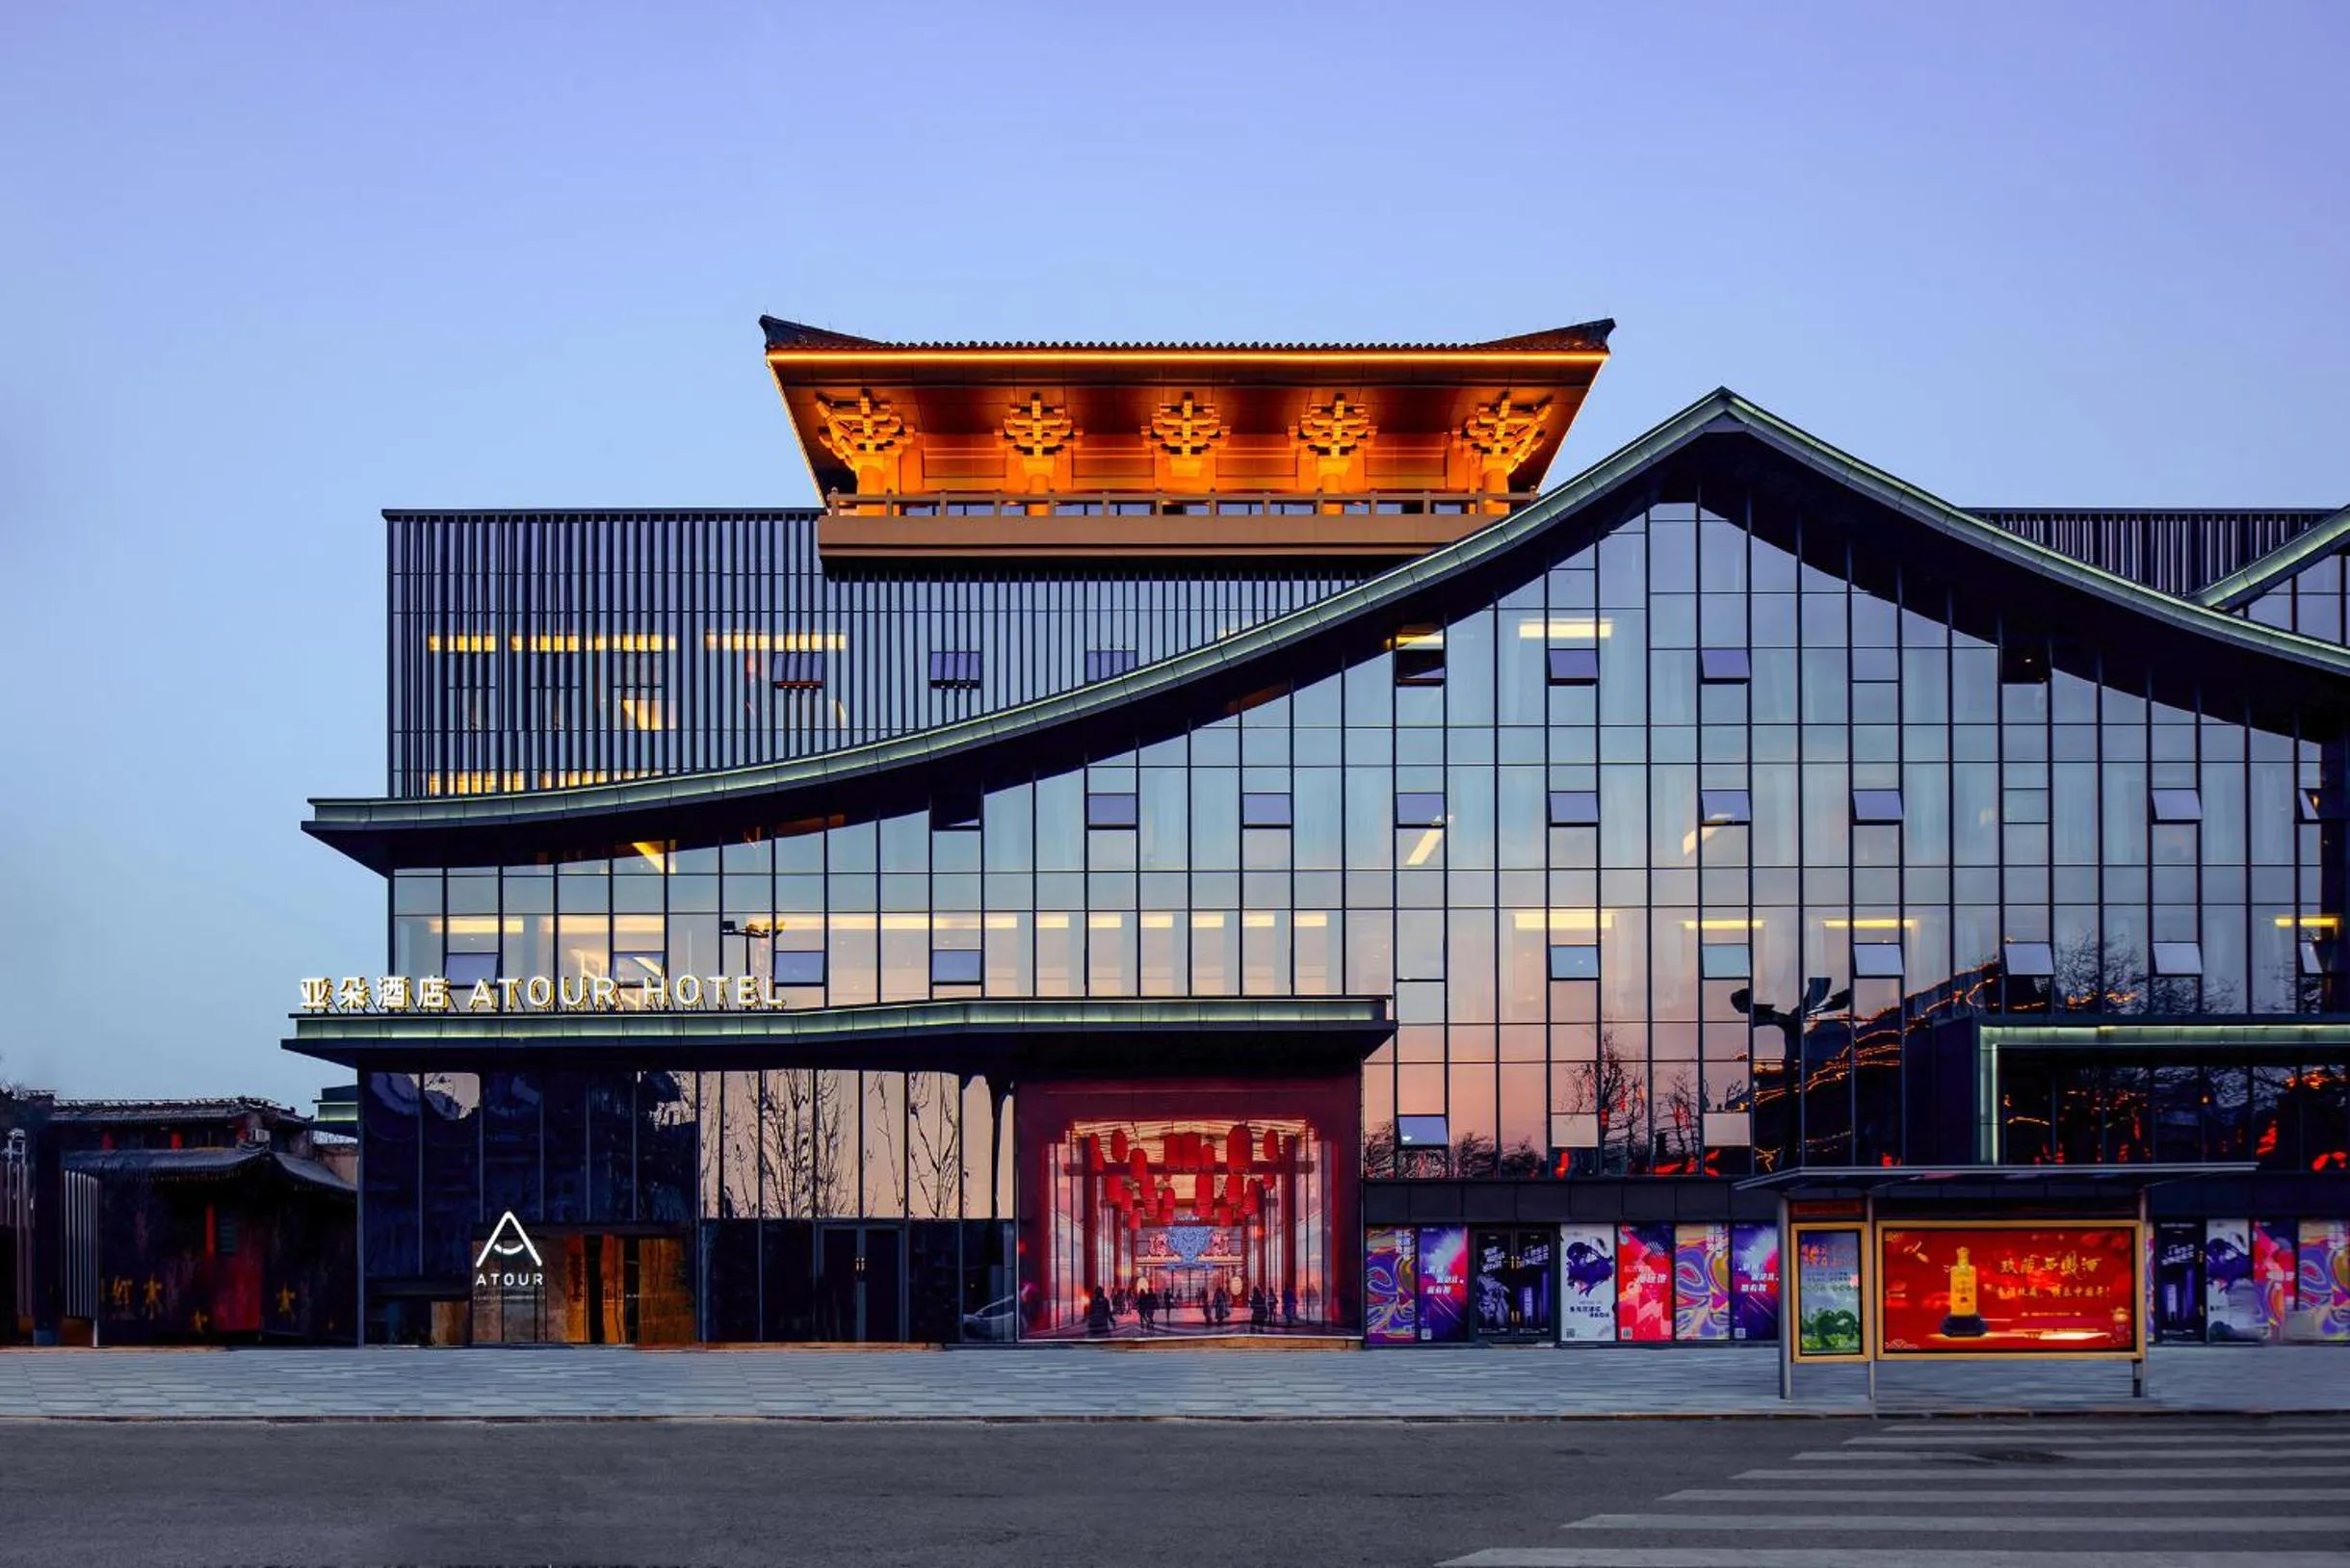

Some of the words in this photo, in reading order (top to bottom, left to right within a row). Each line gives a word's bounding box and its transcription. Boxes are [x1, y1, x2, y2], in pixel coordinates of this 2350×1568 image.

[300, 976, 450, 1010] 亚朵酒店
[468, 977, 618, 1009] ATOUR
[643, 976, 785, 1008] HOTEL
[475, 1272, 543, 1287] ATOUR
